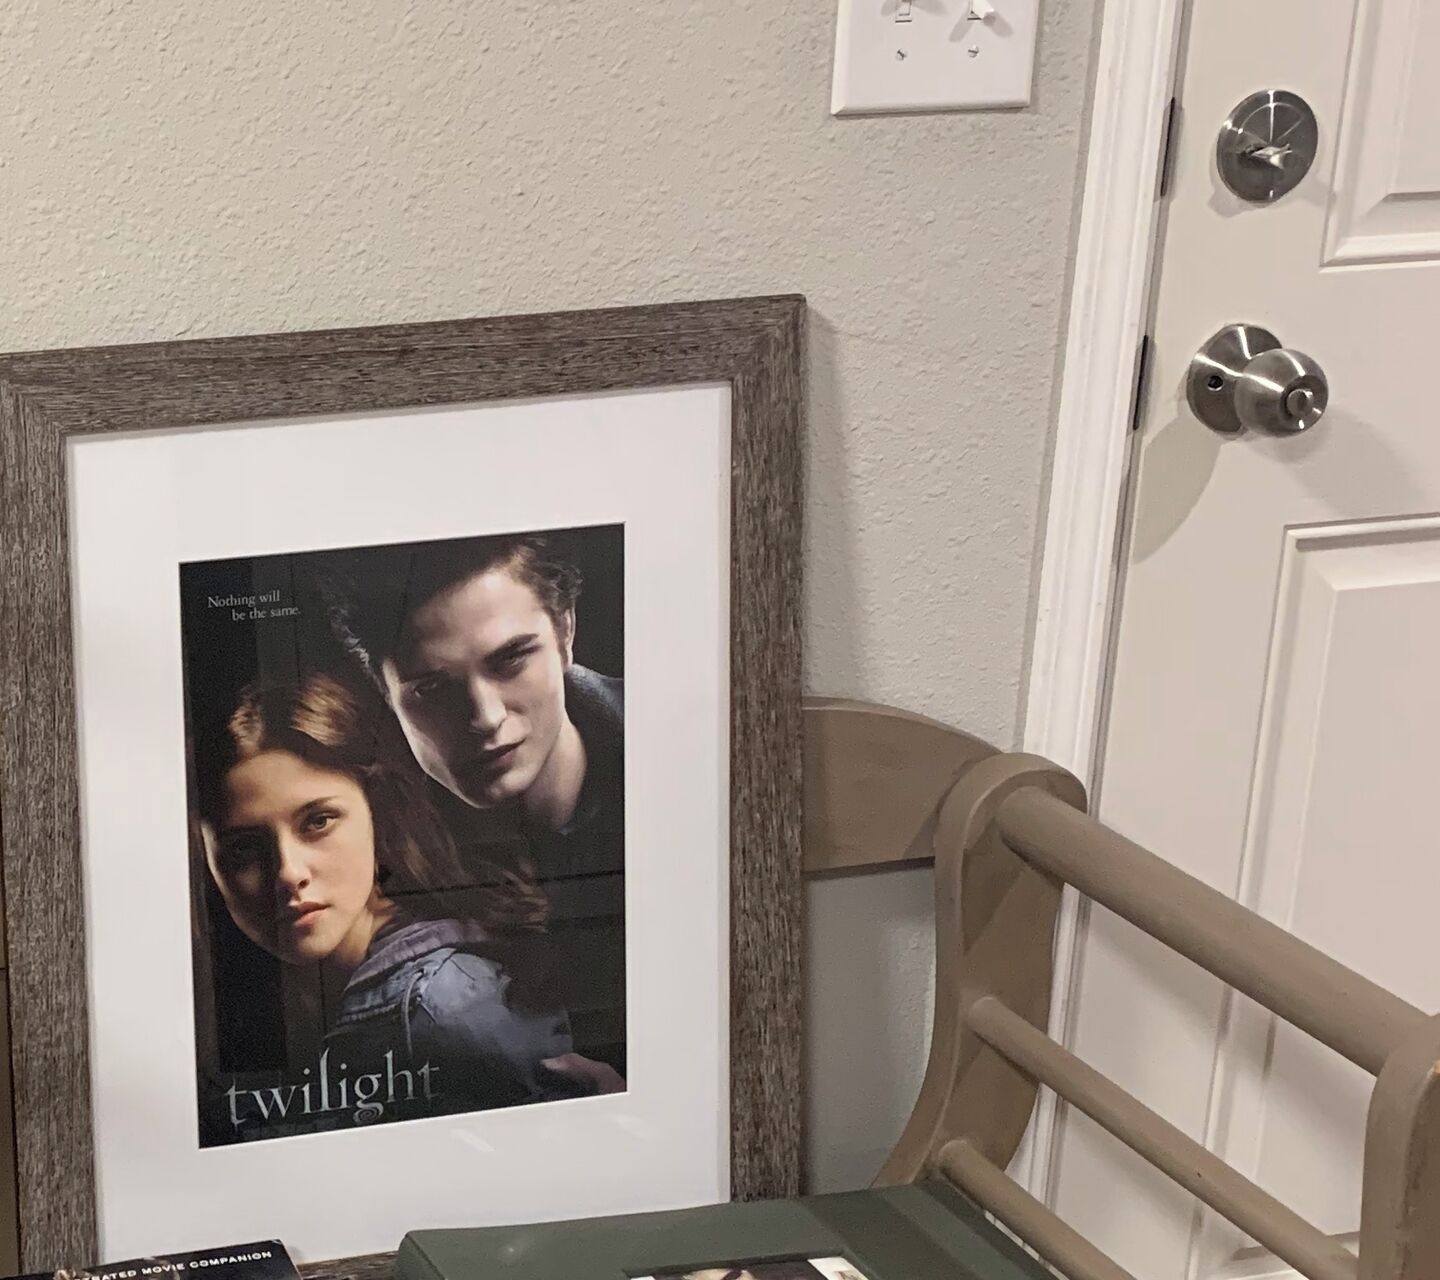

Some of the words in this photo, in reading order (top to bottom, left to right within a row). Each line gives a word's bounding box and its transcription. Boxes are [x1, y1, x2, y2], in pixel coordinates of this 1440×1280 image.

[208, 594, 256, 608] Nothing
[259, 589, 280, 603] will
[231, 608, 247, 621] be
[249, 606, 267, 620] the
[270, 606, 301, 618] same.
[223, 1046, 441, 1126] twilight
[141, 1261, 187, 1277] MOVIE
[189, 1249, 273, 1270] COMPANION
